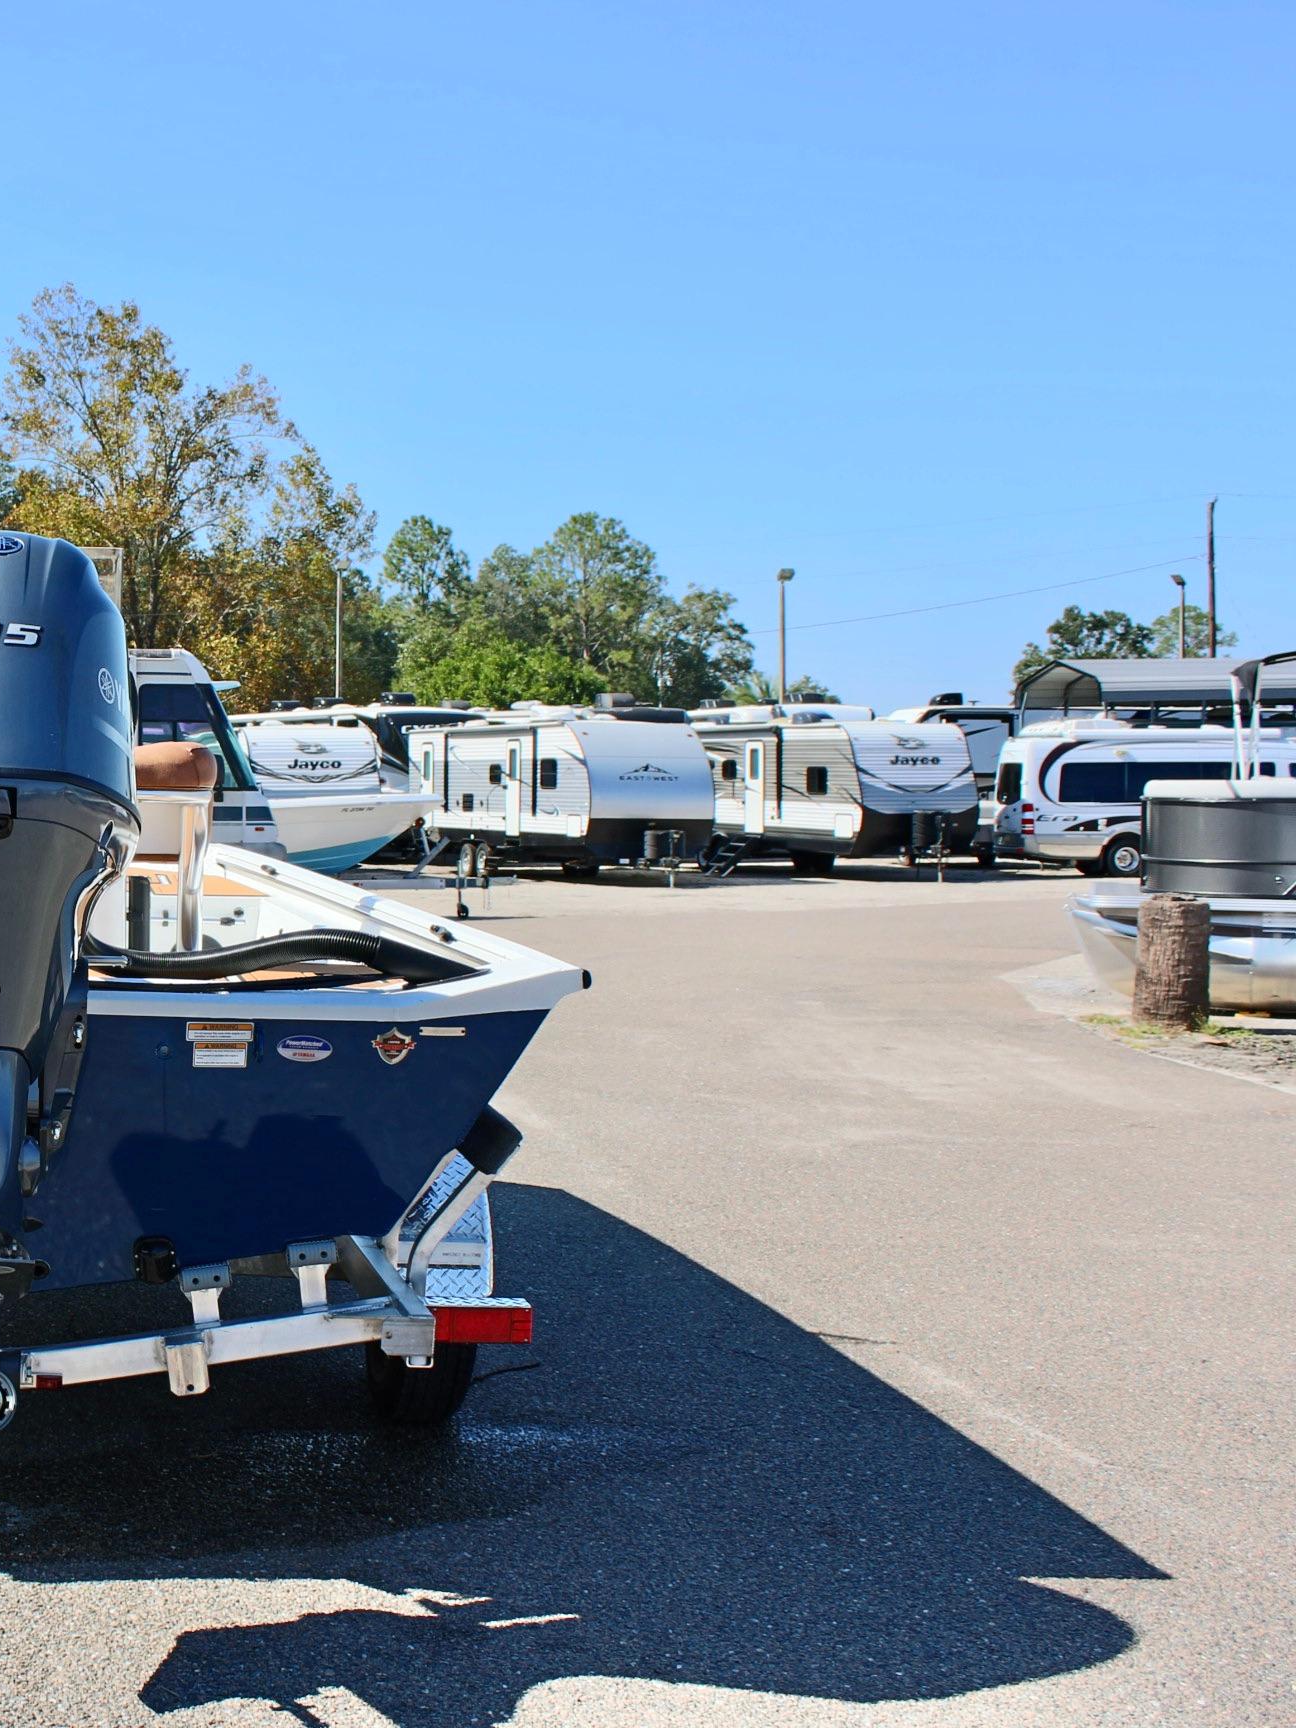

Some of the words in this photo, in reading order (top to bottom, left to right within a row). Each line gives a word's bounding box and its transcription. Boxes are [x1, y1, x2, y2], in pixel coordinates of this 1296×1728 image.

[287, 758, 342, 771] Jayco
[890, 755, 941, 766] Jayco
[1036, 814, 1079, 822] Era
